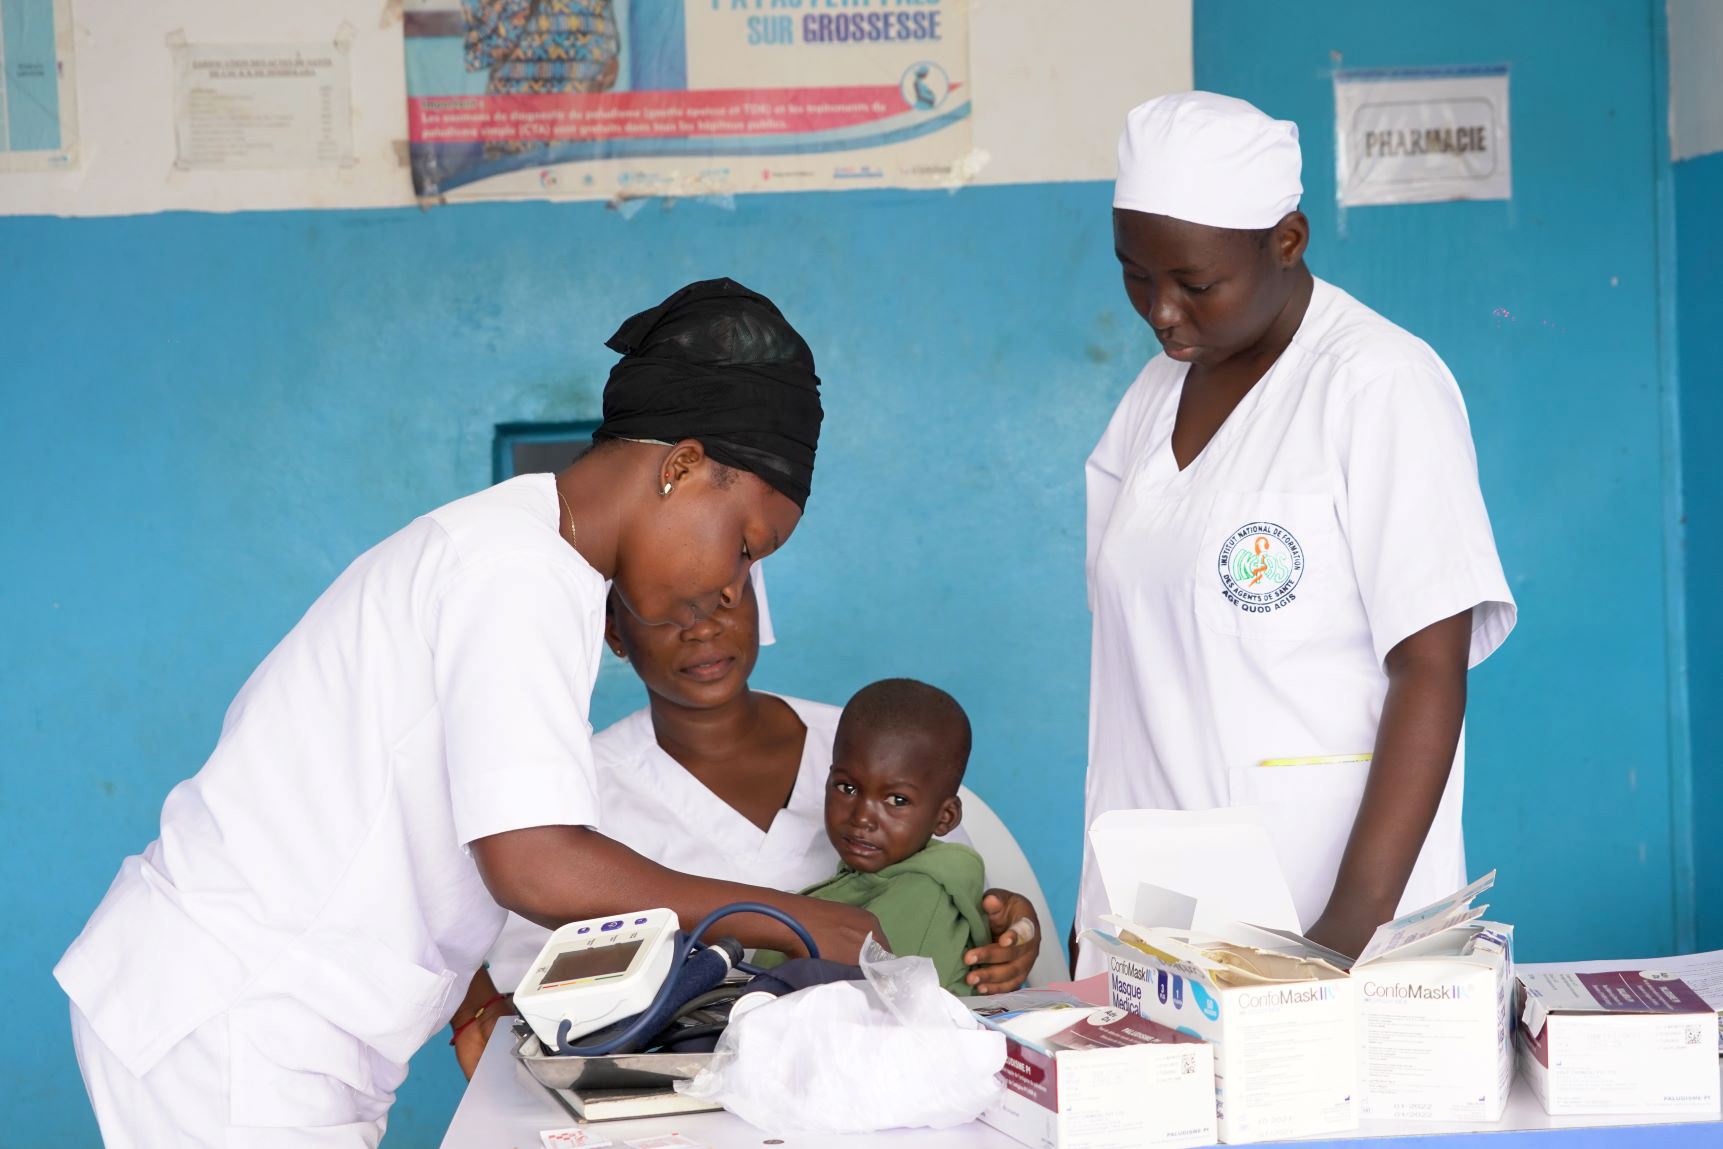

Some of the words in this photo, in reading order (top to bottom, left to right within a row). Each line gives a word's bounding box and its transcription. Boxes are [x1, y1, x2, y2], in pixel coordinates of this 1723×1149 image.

[747, 14, 794, 45] SUR
[802, 10, 942, 44] GROSSESSE
[1365, 126, 1486, 158] PHARMACIE
[1221, 535, 1238, 566] INSTITUT
[1238, 525, 1271, 538] NATIONAL
[1273, 528, 1281, 537] DE
[1282, 534, 1302, 570] FORMATION
[1222, 590, 1239, 607] AGE
[1241, 603, 1272, 613] QUOD
[1275, 593, 1296, 610] AGIS
[1223, 574, 1234, 589] DES
[1233, 587, 1262, 602] AGENTS
[1263, 594, 1273, 602] DE
[1112, 973, 1142, 1002] Masque
